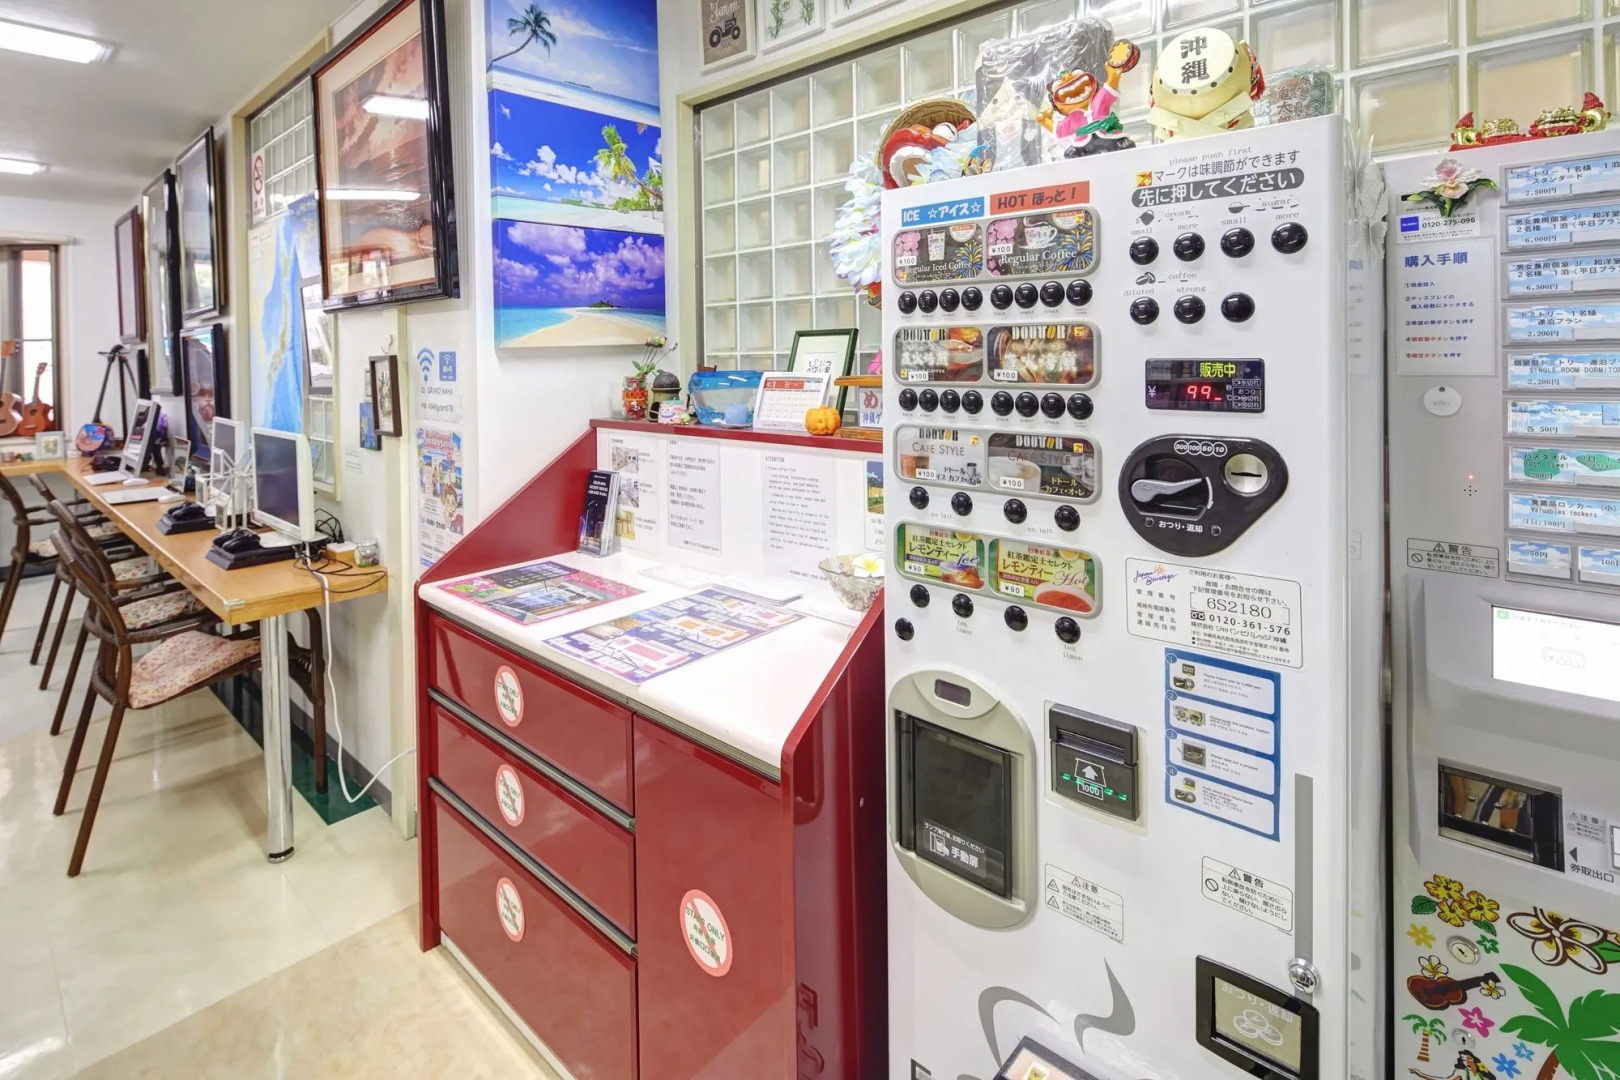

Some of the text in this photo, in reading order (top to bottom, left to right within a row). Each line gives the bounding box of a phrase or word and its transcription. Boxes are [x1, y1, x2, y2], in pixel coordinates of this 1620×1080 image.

[1180, 35, 1211, 84] 沖縄
[1169, 146, 1252, 165] please push first
[1154, 150, 1300, 181] マークは味調節ができます
[1532, 173, 1583, 184] スタンダード
[1138, 174, 1296, 206] 先に押してください
[997, 195, 1027, 209] HOT
[1261, 198, 1292, 207] sugar
[903, 208, 920, 222] ICE
[1221, 212, 1299, 225] small more
[1178, 222, 1198, 230] more
[1422, 218, 1475, 228] 0120-275-096
[991, 245, 1011, 253] ¥100
[1000, 249, 1077, 265] Regular Coffee
[1404, 251, 1469, 268] 購入手順
[904, 261, 972, 275] Regular Iced Coffee
[1168, 272, 1197, 280] coffee
[1123, 285, 1206, 297] diluted strong
[903, 328, 946, 341] DOUTOR
[1011, 326, 1066, 340] DOUTOR
[1199, 362, 1236, 378] 販売中
[1529, 366, 1557, 374] SINGLE
[1148, 386, 1157, 397] ¥
[919, 428, 959, 441] DOUTOR
[1015, 434, 1063, 449] DOUTOR
[912, 442, 965, 456] CAFE STYLE
[1175, 443, 1188, 451] 500
[1189, 443, 1201, 451] 100
[1040, 452, 1071, 465] STYLE
[944, 466, 966, 474] ドトール
[1002, 479, 1022, 487] ¥100
[1051, 477, 1078, 486] ドトール
[1045, 485, 1085, 496] カフェ・オ・レ
[1531, 507, 1598, 518] Valuables lockers
[1158, 520, 1203, 533] おつり・返却
[912, 535, 967, 550] 紅茶鑑定士セレクト
[909, 542, 960, 559] レモンティー
[955, 551, 980, 566] Ice
[1007, 550, 1073, 570] 紅茶鑑定士セレクト
[909, 564, 922, 572] ¥90
[1002, 559, 1054, 578] レモンティー
[1053, 570, 1088, 586] Hot
[1189, 569, 1237, 581] ご利用のお客様へ
[1004, 584, 1020, 594] ¥90
[1205, 580, 1272, 596] 故障・お問合せの際は
[1192, 586, 1288, 606] 下記管理番号をお知らせ下さい。
[1207, 597, 1272, 619] 6S2180
[1209, 614, 1291, 636] 0120-361-576
[951, 846, 979, 868] 手動扉
[1569, 863, 1614, 883] 券取出口
[1082, 880, 1098, 894] 注意
[1243, 872, 1264, 889] 警告
[706, 923, 725, 942] ONLY
